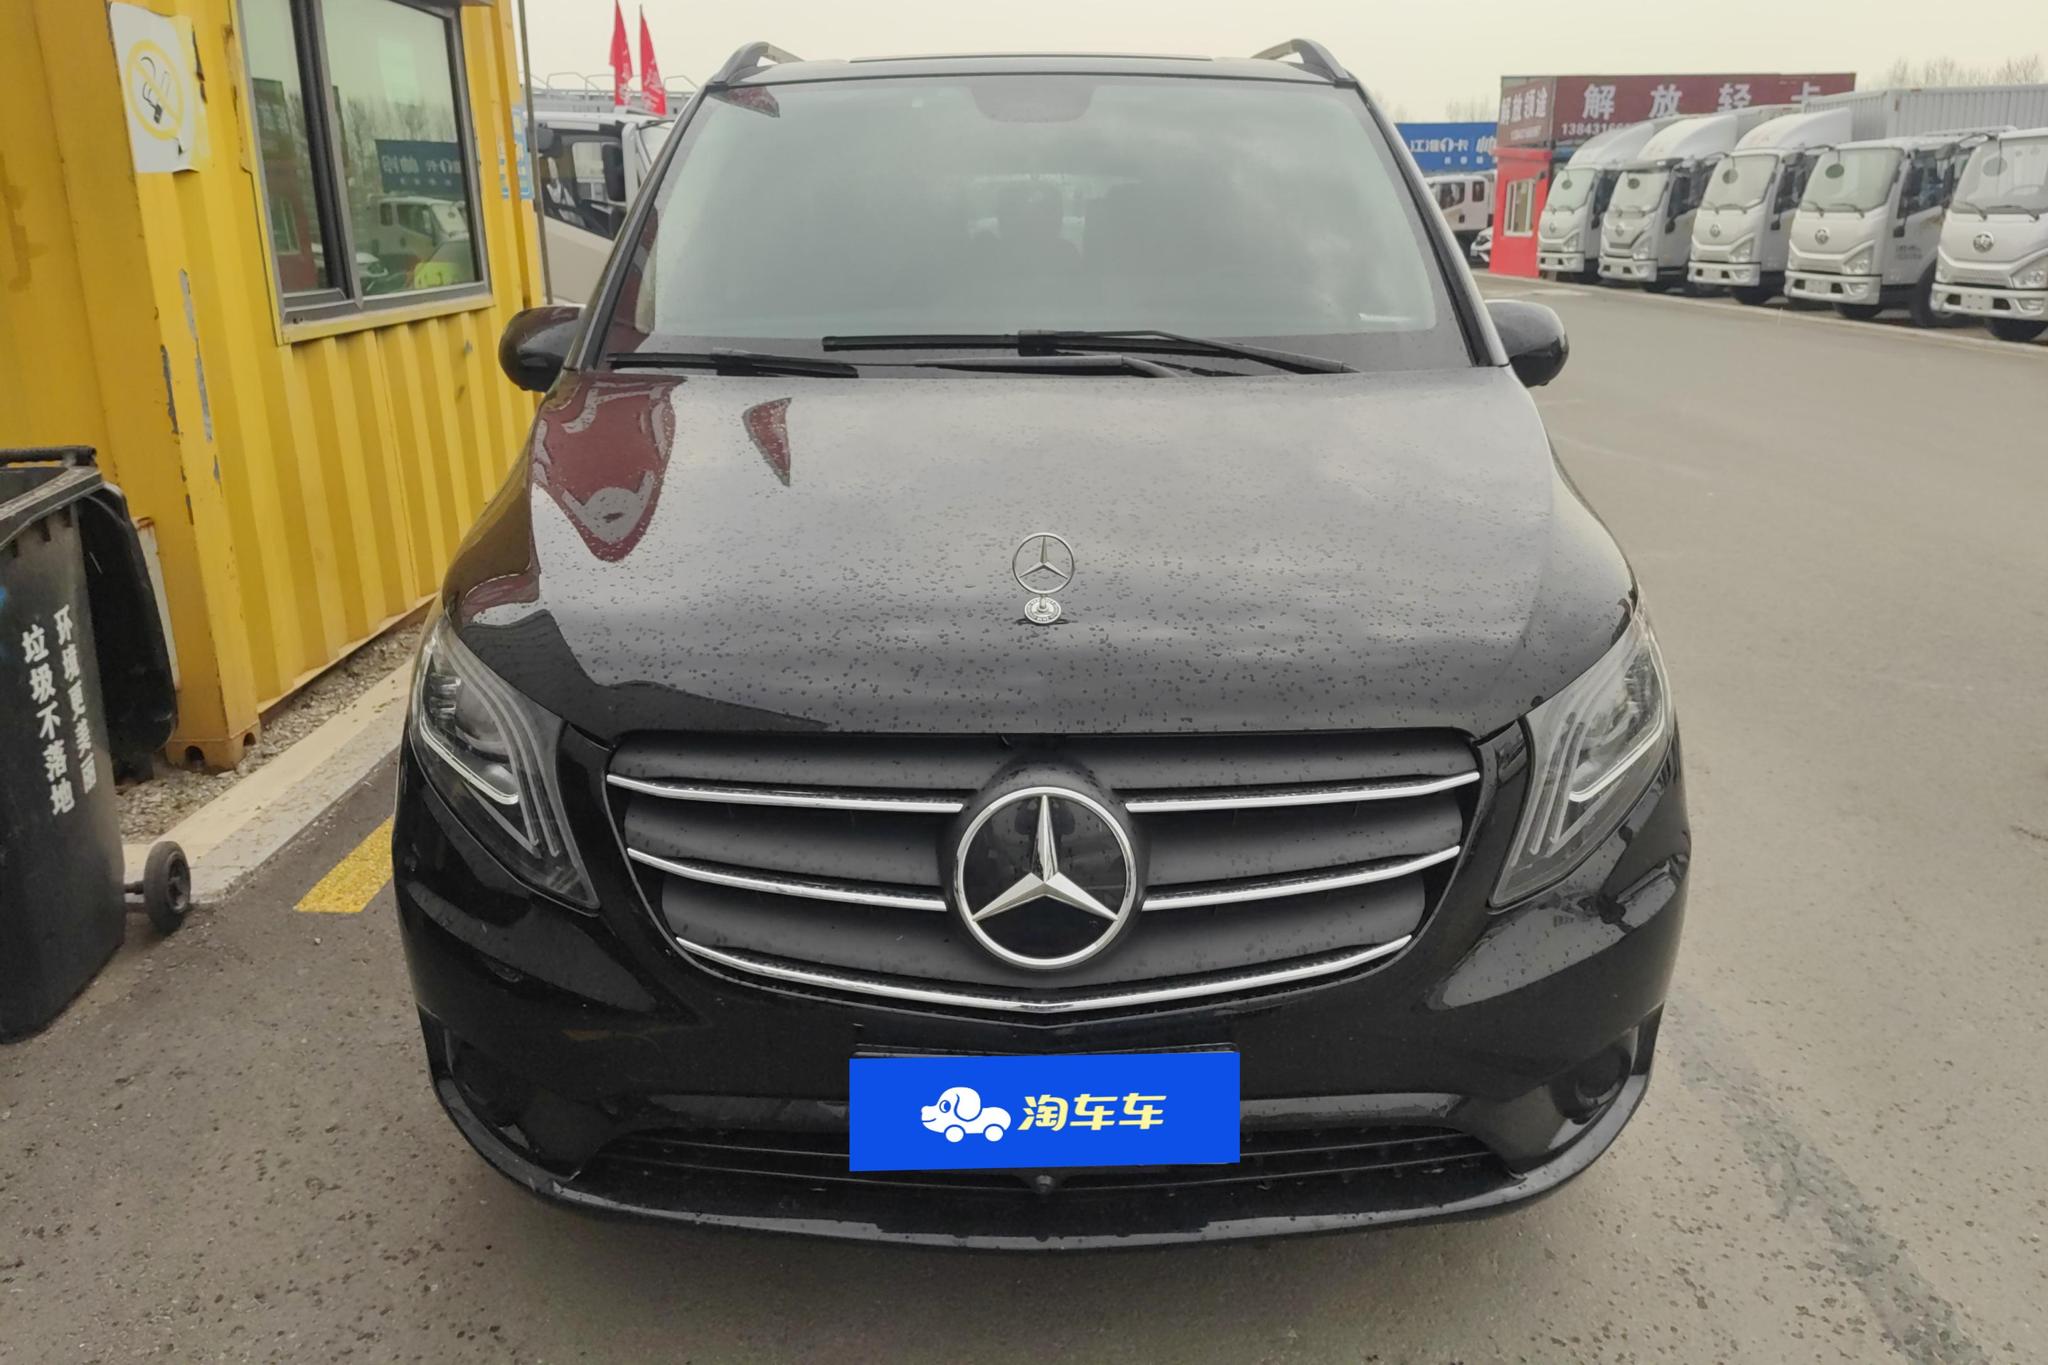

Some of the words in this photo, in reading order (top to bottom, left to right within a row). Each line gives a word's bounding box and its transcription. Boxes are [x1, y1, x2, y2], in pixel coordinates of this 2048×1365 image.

[22, 624, 75, 815] 垃圾不落地
[54, 604, 97, 794] 环境更美丽
